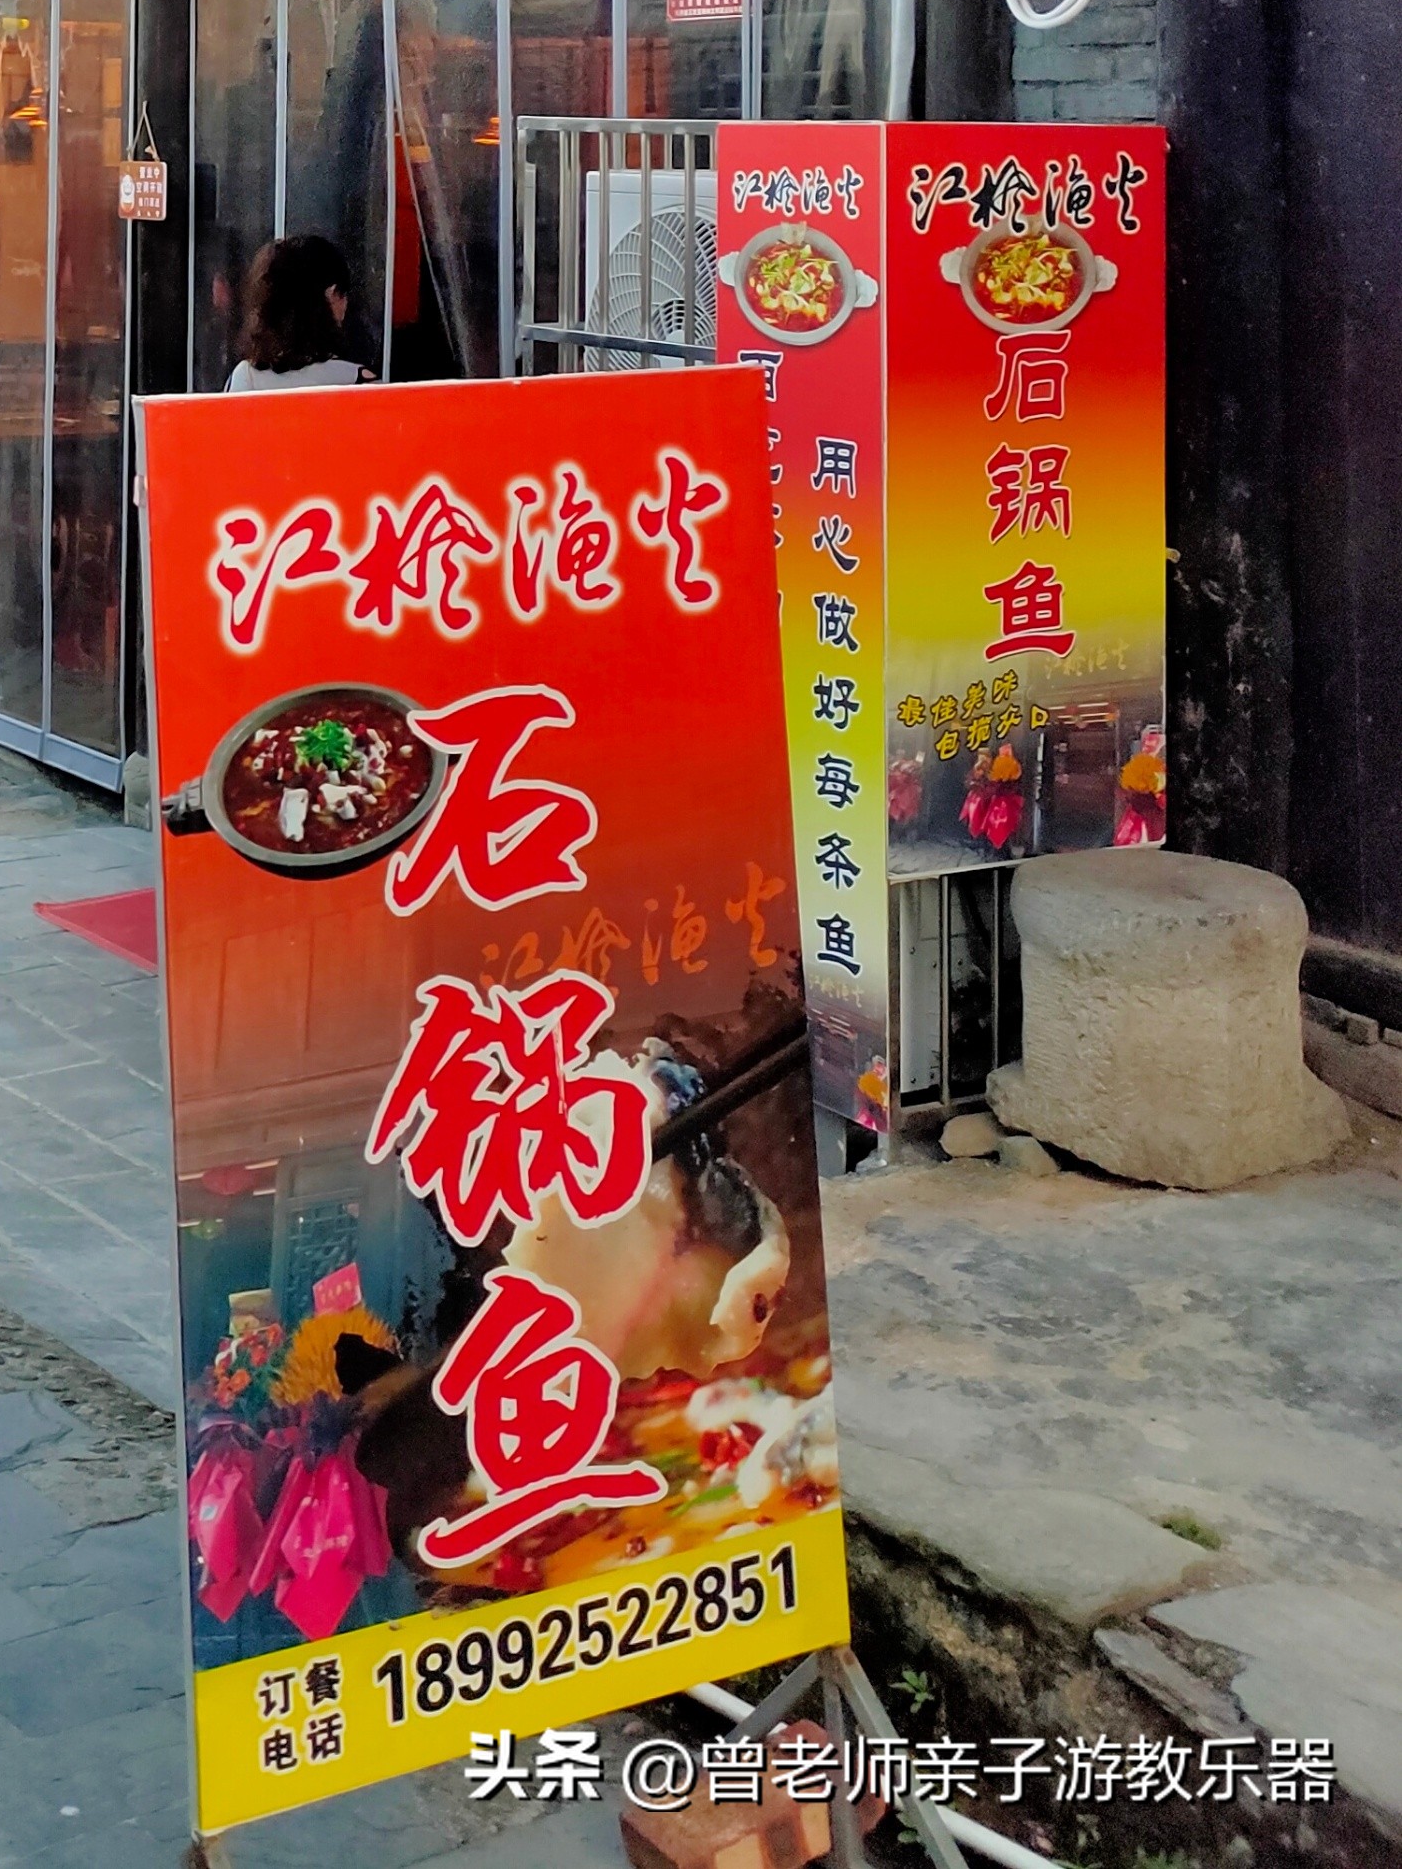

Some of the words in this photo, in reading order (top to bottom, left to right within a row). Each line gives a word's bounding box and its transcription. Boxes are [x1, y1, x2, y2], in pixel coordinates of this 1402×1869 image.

[983, 330, 1074, 663] 石锅鱼
[810, 436, 862, 978] 用心做好每条鱼
[898, 668, 1019, 728] 最佳美味
[366, 684, 668, 1567] 石锅鱼
[258, 1655, 342, 1720] 订餐
[374, 1543, 799, 1724] 18992522851
[260, 1709, 345, 1772] 电话
